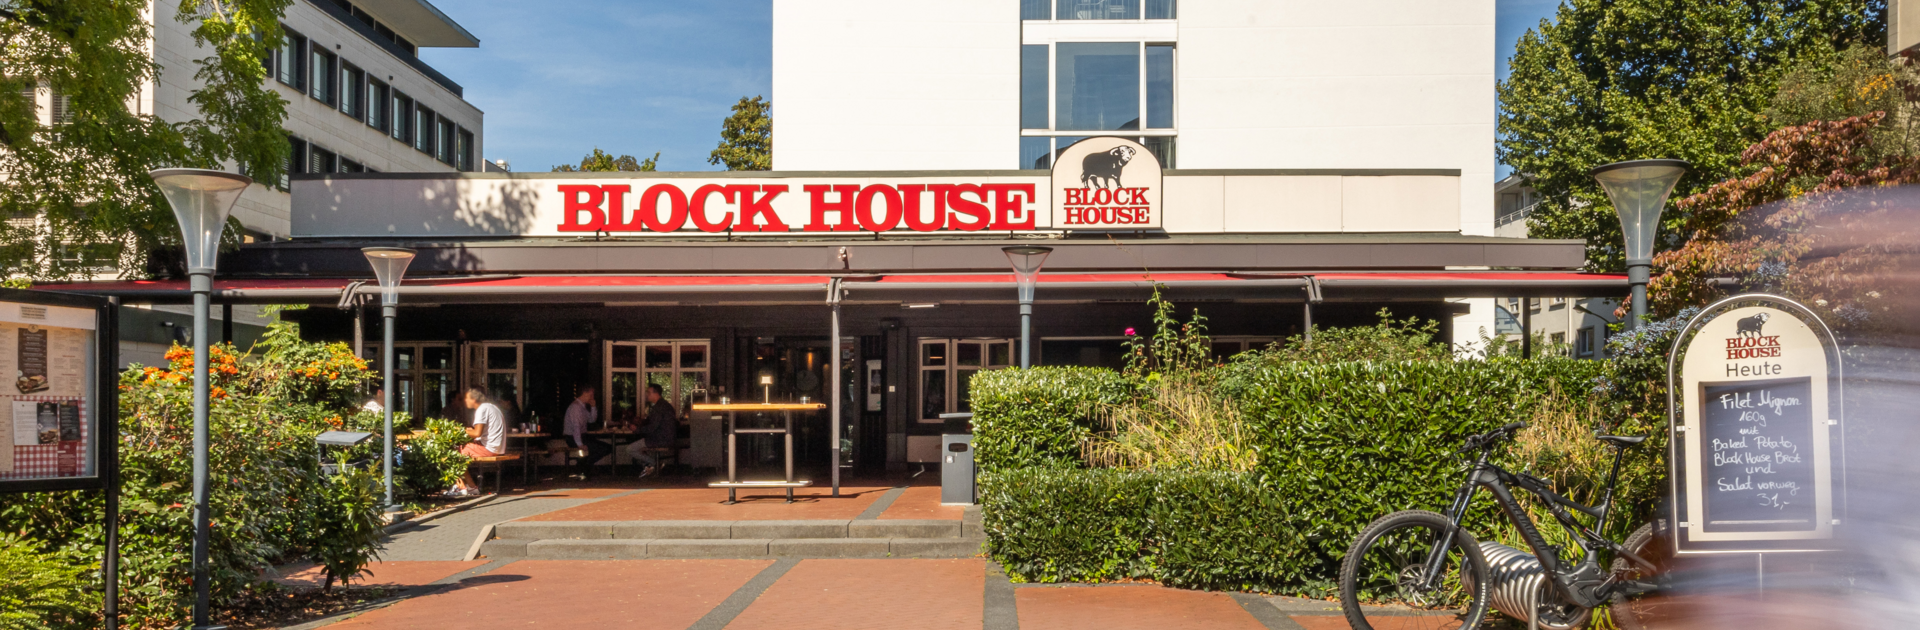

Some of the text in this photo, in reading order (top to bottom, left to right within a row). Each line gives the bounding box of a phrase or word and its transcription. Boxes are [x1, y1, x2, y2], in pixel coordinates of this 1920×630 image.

[1064, 187, 1150, 206] BLOCK
[557, 183, 1036, 232] BLOCK HOUSE
[1064, 206, 1150, 225] HOUSE
[1725, 335, 1780, 349] BLOCK
[1726, 346, 1781, 360] HOUSE
[1726, 361, 1782, 377] Heute
[1719, 389, 1802, 416] Filet Mignon
[1739, 411, 1766, 427] 160g
[1739, 426, 1759, 435] mit
[1712, 436, 1748, 452] Baked
[1714, 451, 1743, 467] Block
[1745, 451, 1771, 464] House
[1745, 462, 1776, 474] und
[1717, 475, 1753, 492] Salat
[1507, 497, 1549, 551] SPECIALIZED
